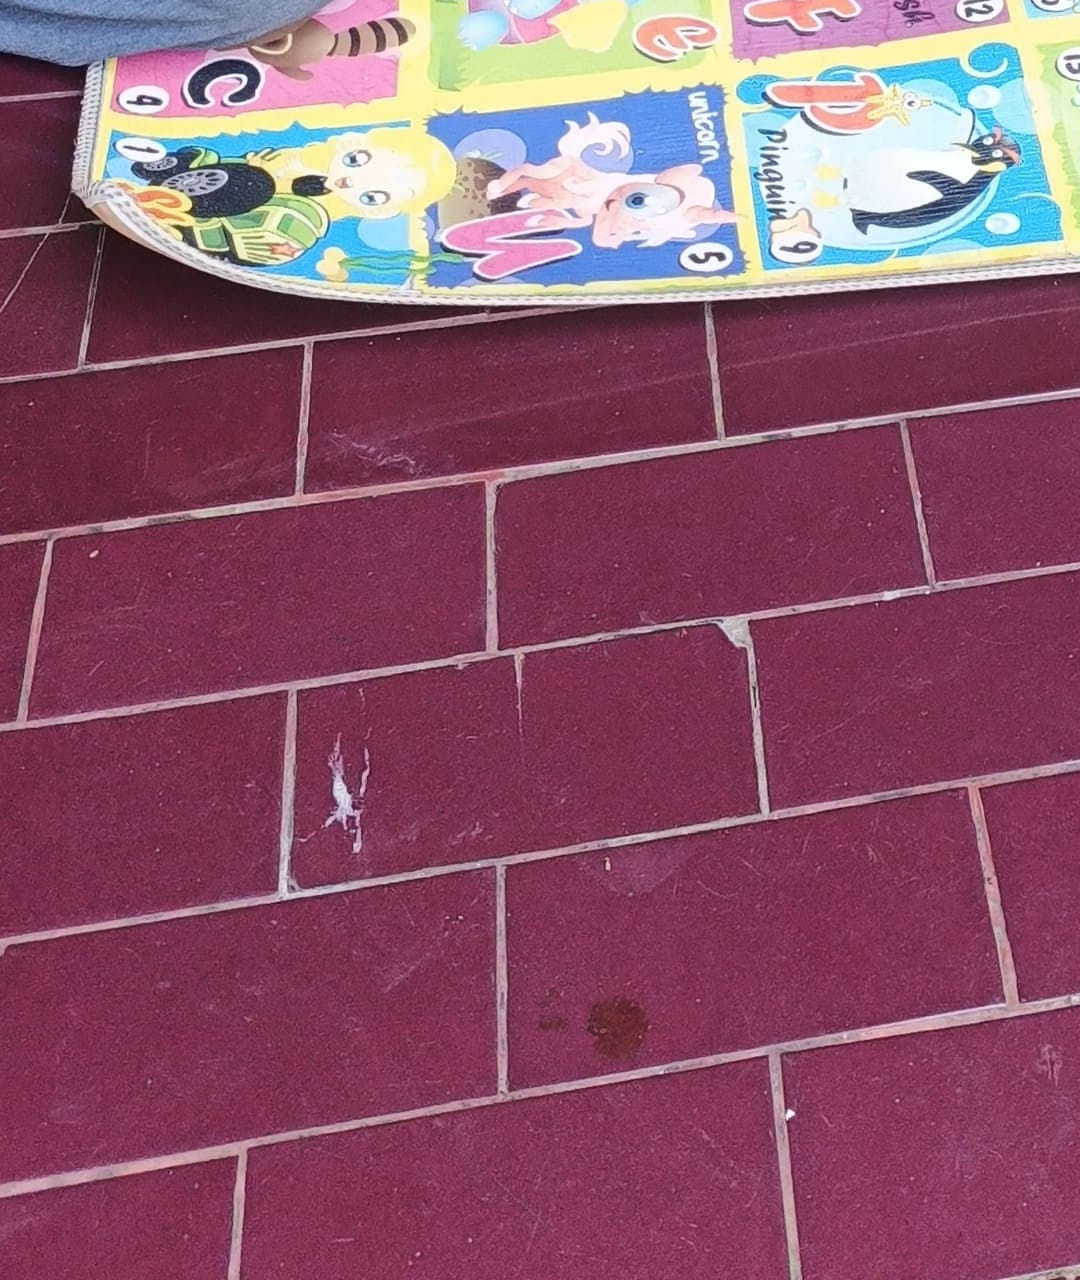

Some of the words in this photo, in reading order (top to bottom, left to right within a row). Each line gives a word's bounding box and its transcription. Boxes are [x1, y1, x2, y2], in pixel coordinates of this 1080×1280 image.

[688, 90, 721, 165] unicorn
[122, 144, 160, 155] 1
[753, 128, 797, 221] Pinguin
[778, 240, 819, 254] 9
[687, 251, 727, 265] 5
